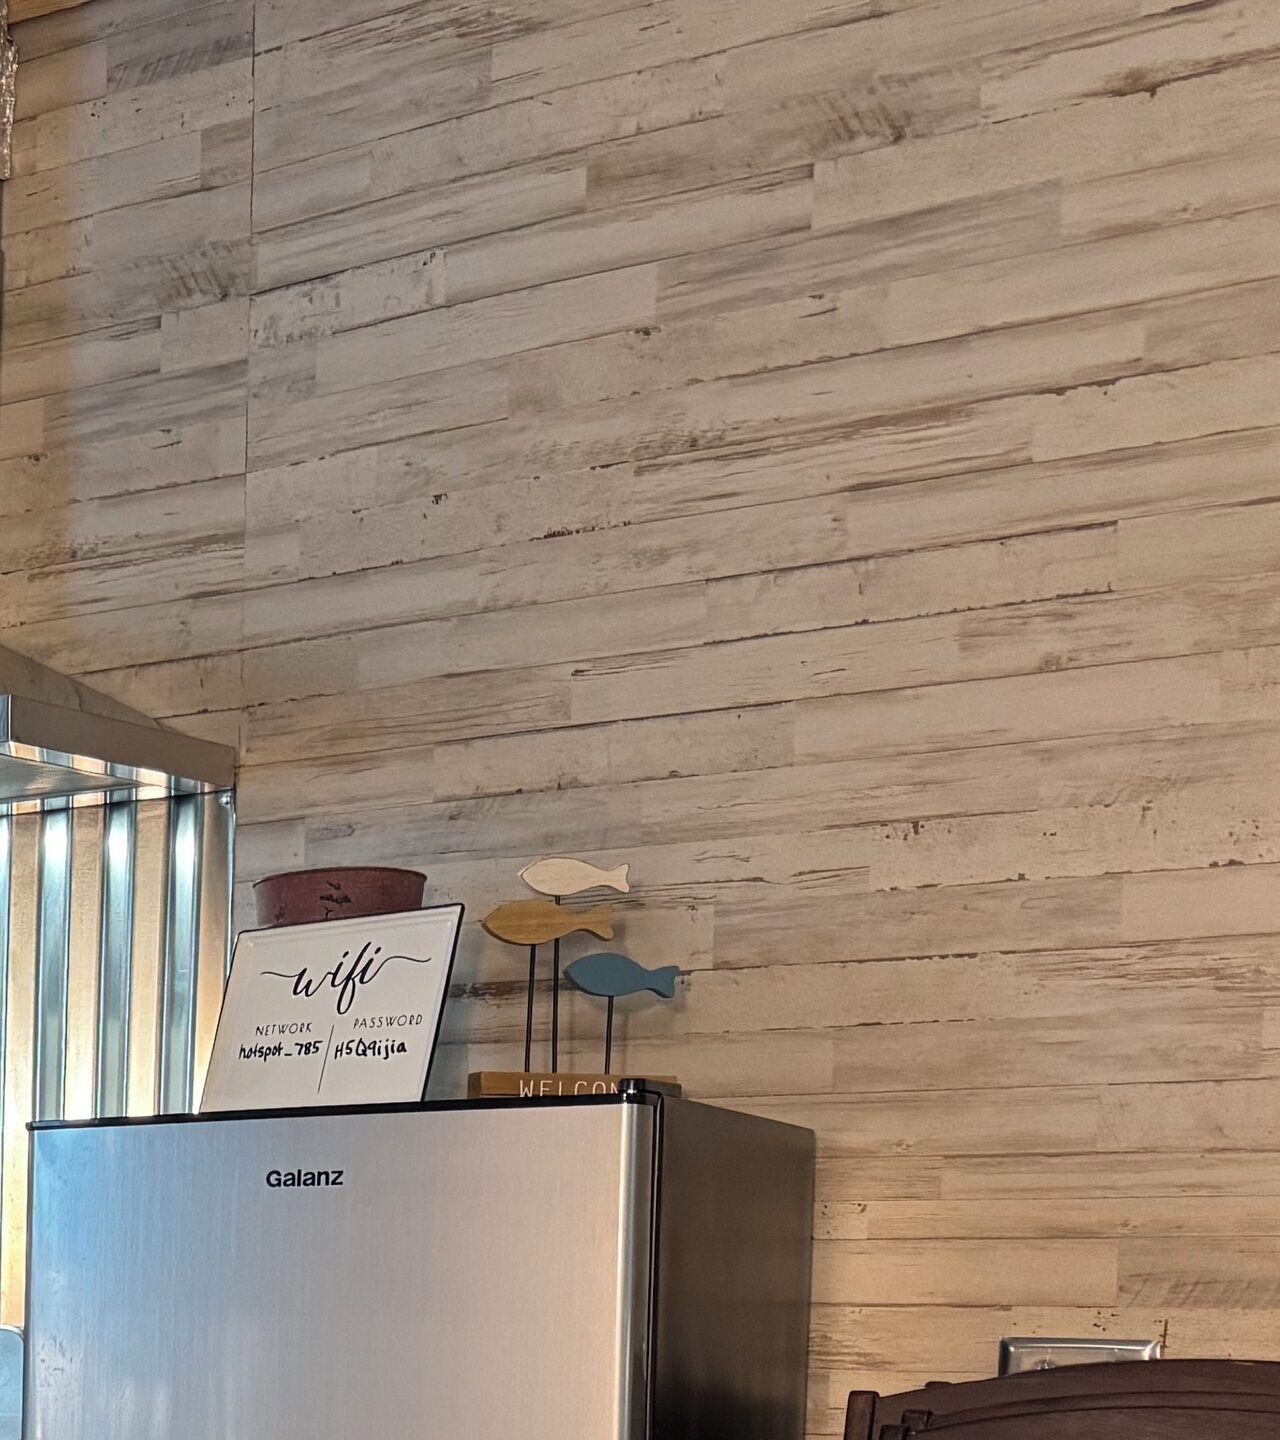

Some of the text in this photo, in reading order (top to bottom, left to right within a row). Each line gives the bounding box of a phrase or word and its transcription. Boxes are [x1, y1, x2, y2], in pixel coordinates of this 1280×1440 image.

[260, 941, 432, 1015] wifi
[256, 1013, 423, 1036] NETWORK PASSWORD
[239, 1039, 324, 1063] hotspot_785
[519, 1079, 620, 1098] WELCO
[265, 1169, 344, 1188] Galanz
